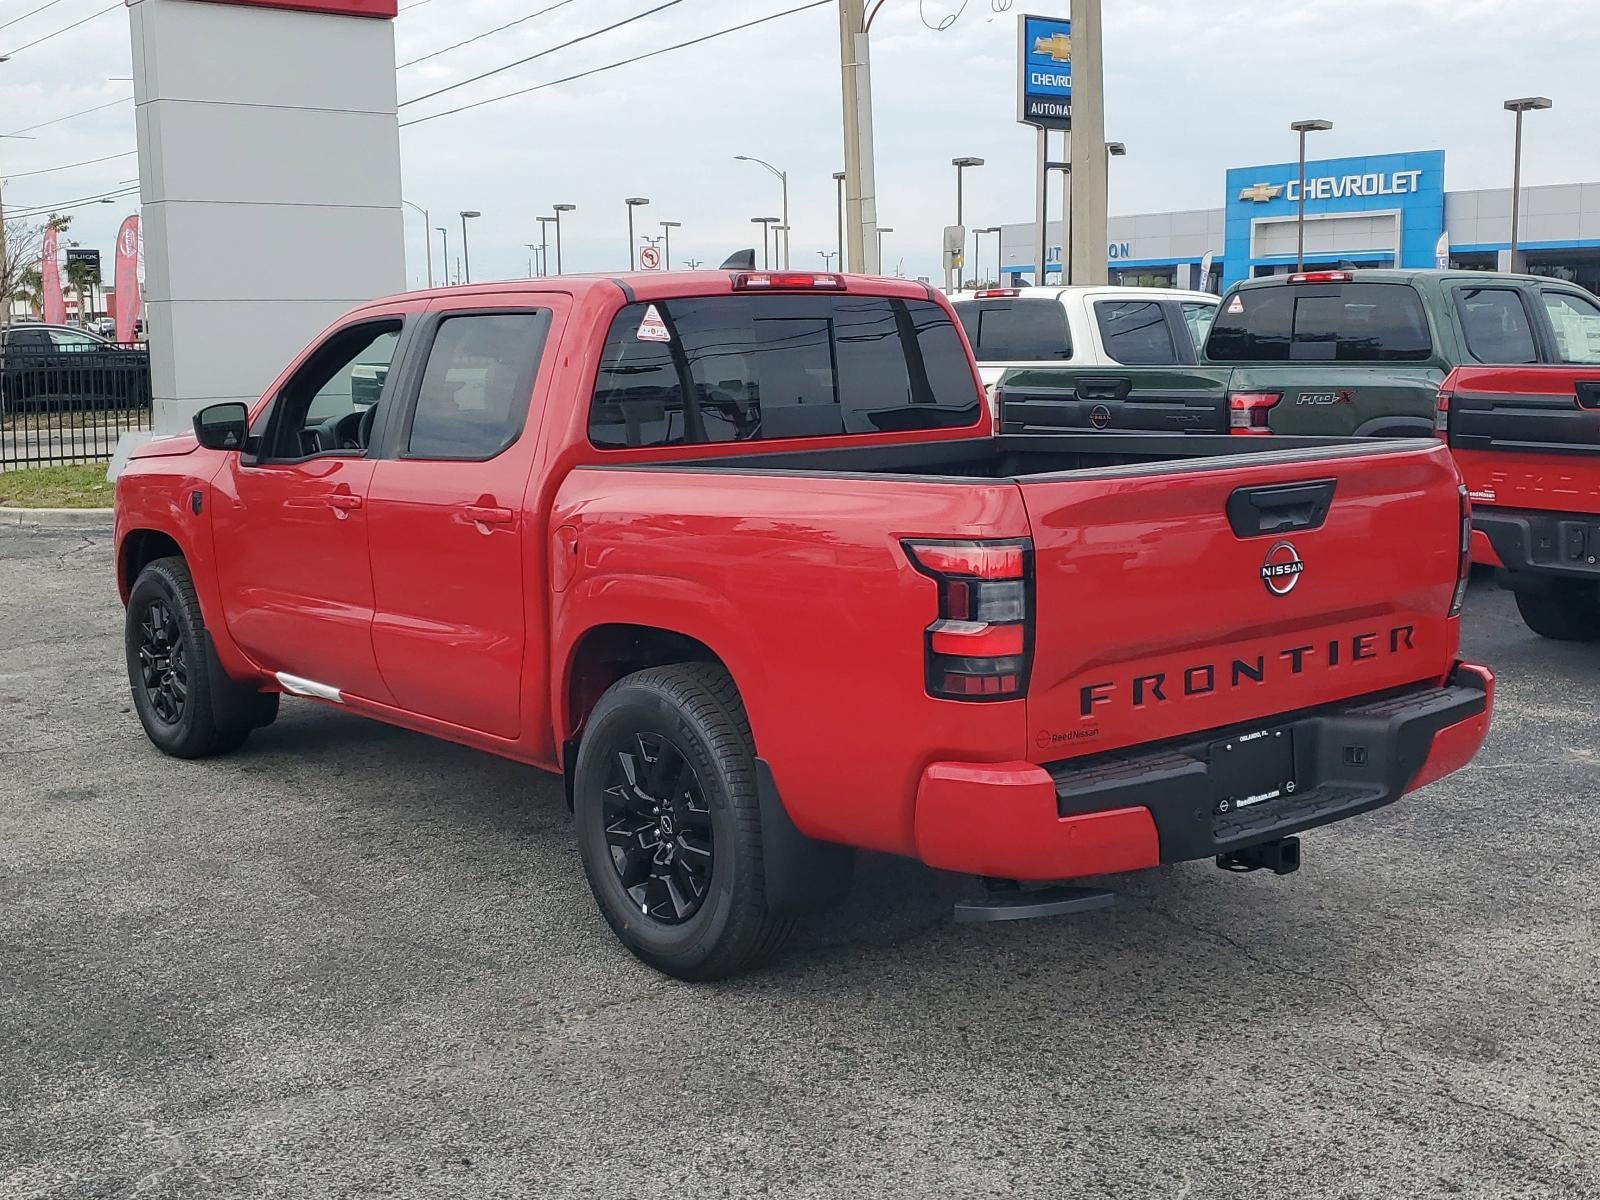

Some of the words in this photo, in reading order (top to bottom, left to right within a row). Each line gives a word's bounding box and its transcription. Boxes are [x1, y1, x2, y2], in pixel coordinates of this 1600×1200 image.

[1286, 170, 1422, 200] CHEVROLET
[1262, 562, 1304, 577] NISSAN
[1079, 625, 1414, 716] FRONTIER
[1051, 731, 1072, 743] Reed
[1073, 728, 1099, 739] Nissan
[1236, 790, 1280, 807] ReedNissan.com
